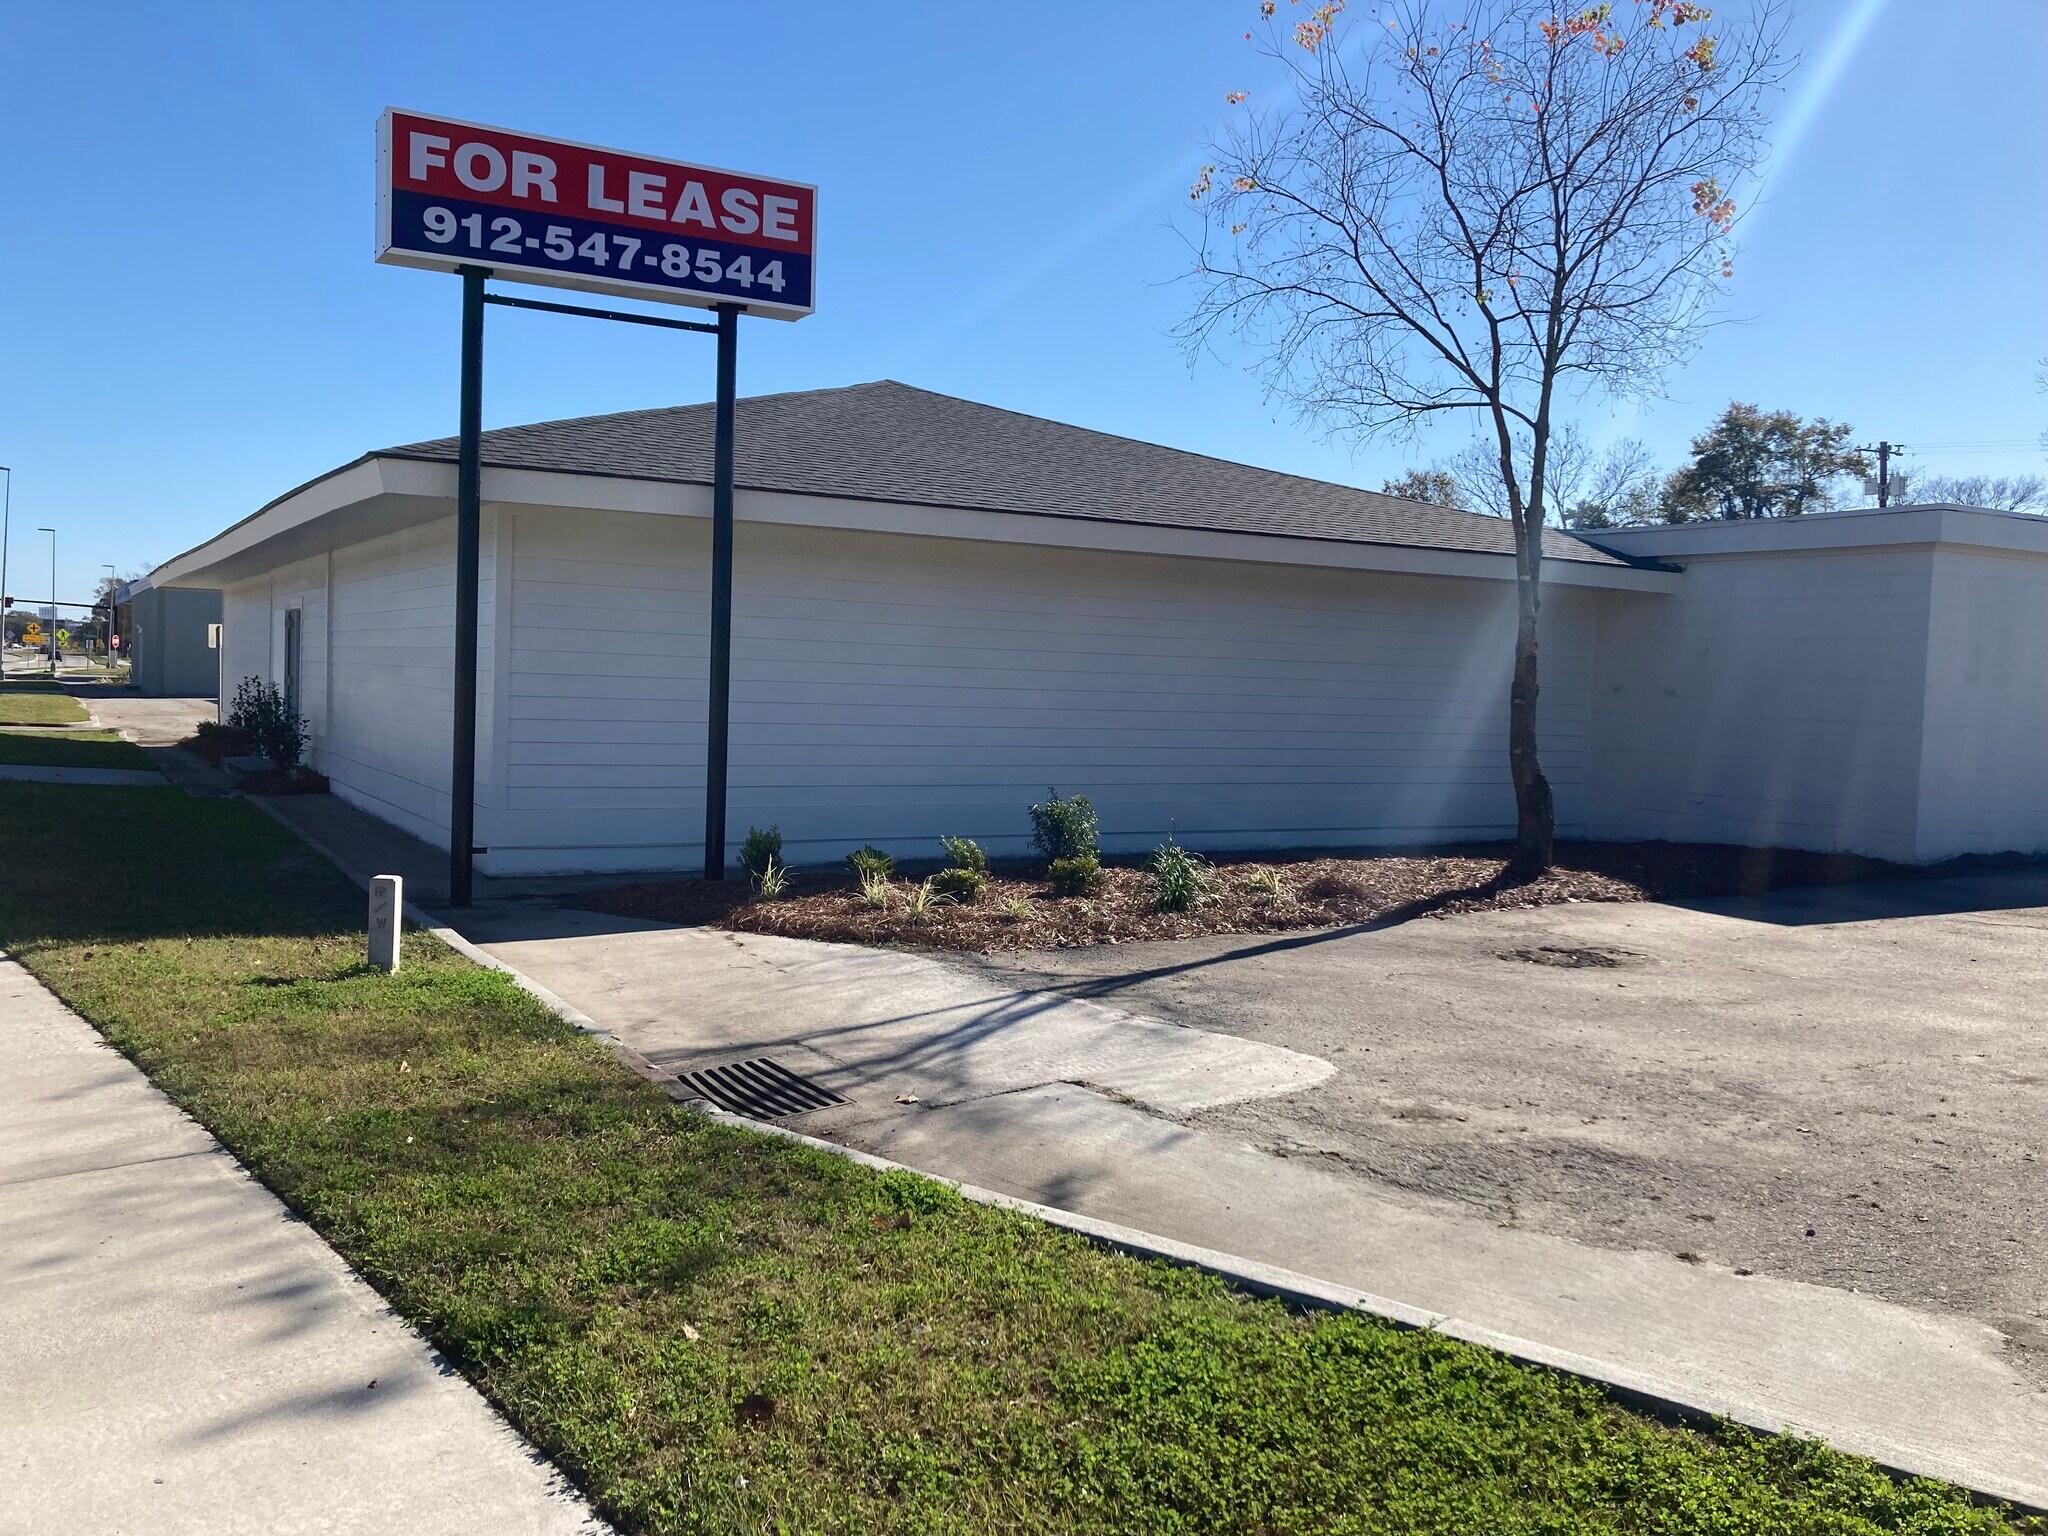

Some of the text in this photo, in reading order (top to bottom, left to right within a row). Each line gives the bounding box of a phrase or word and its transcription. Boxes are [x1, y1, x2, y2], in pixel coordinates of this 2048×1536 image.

[409, 131, 798, 242] FOR LEASE
[422, 206, 786, 293] 912-547-8544
